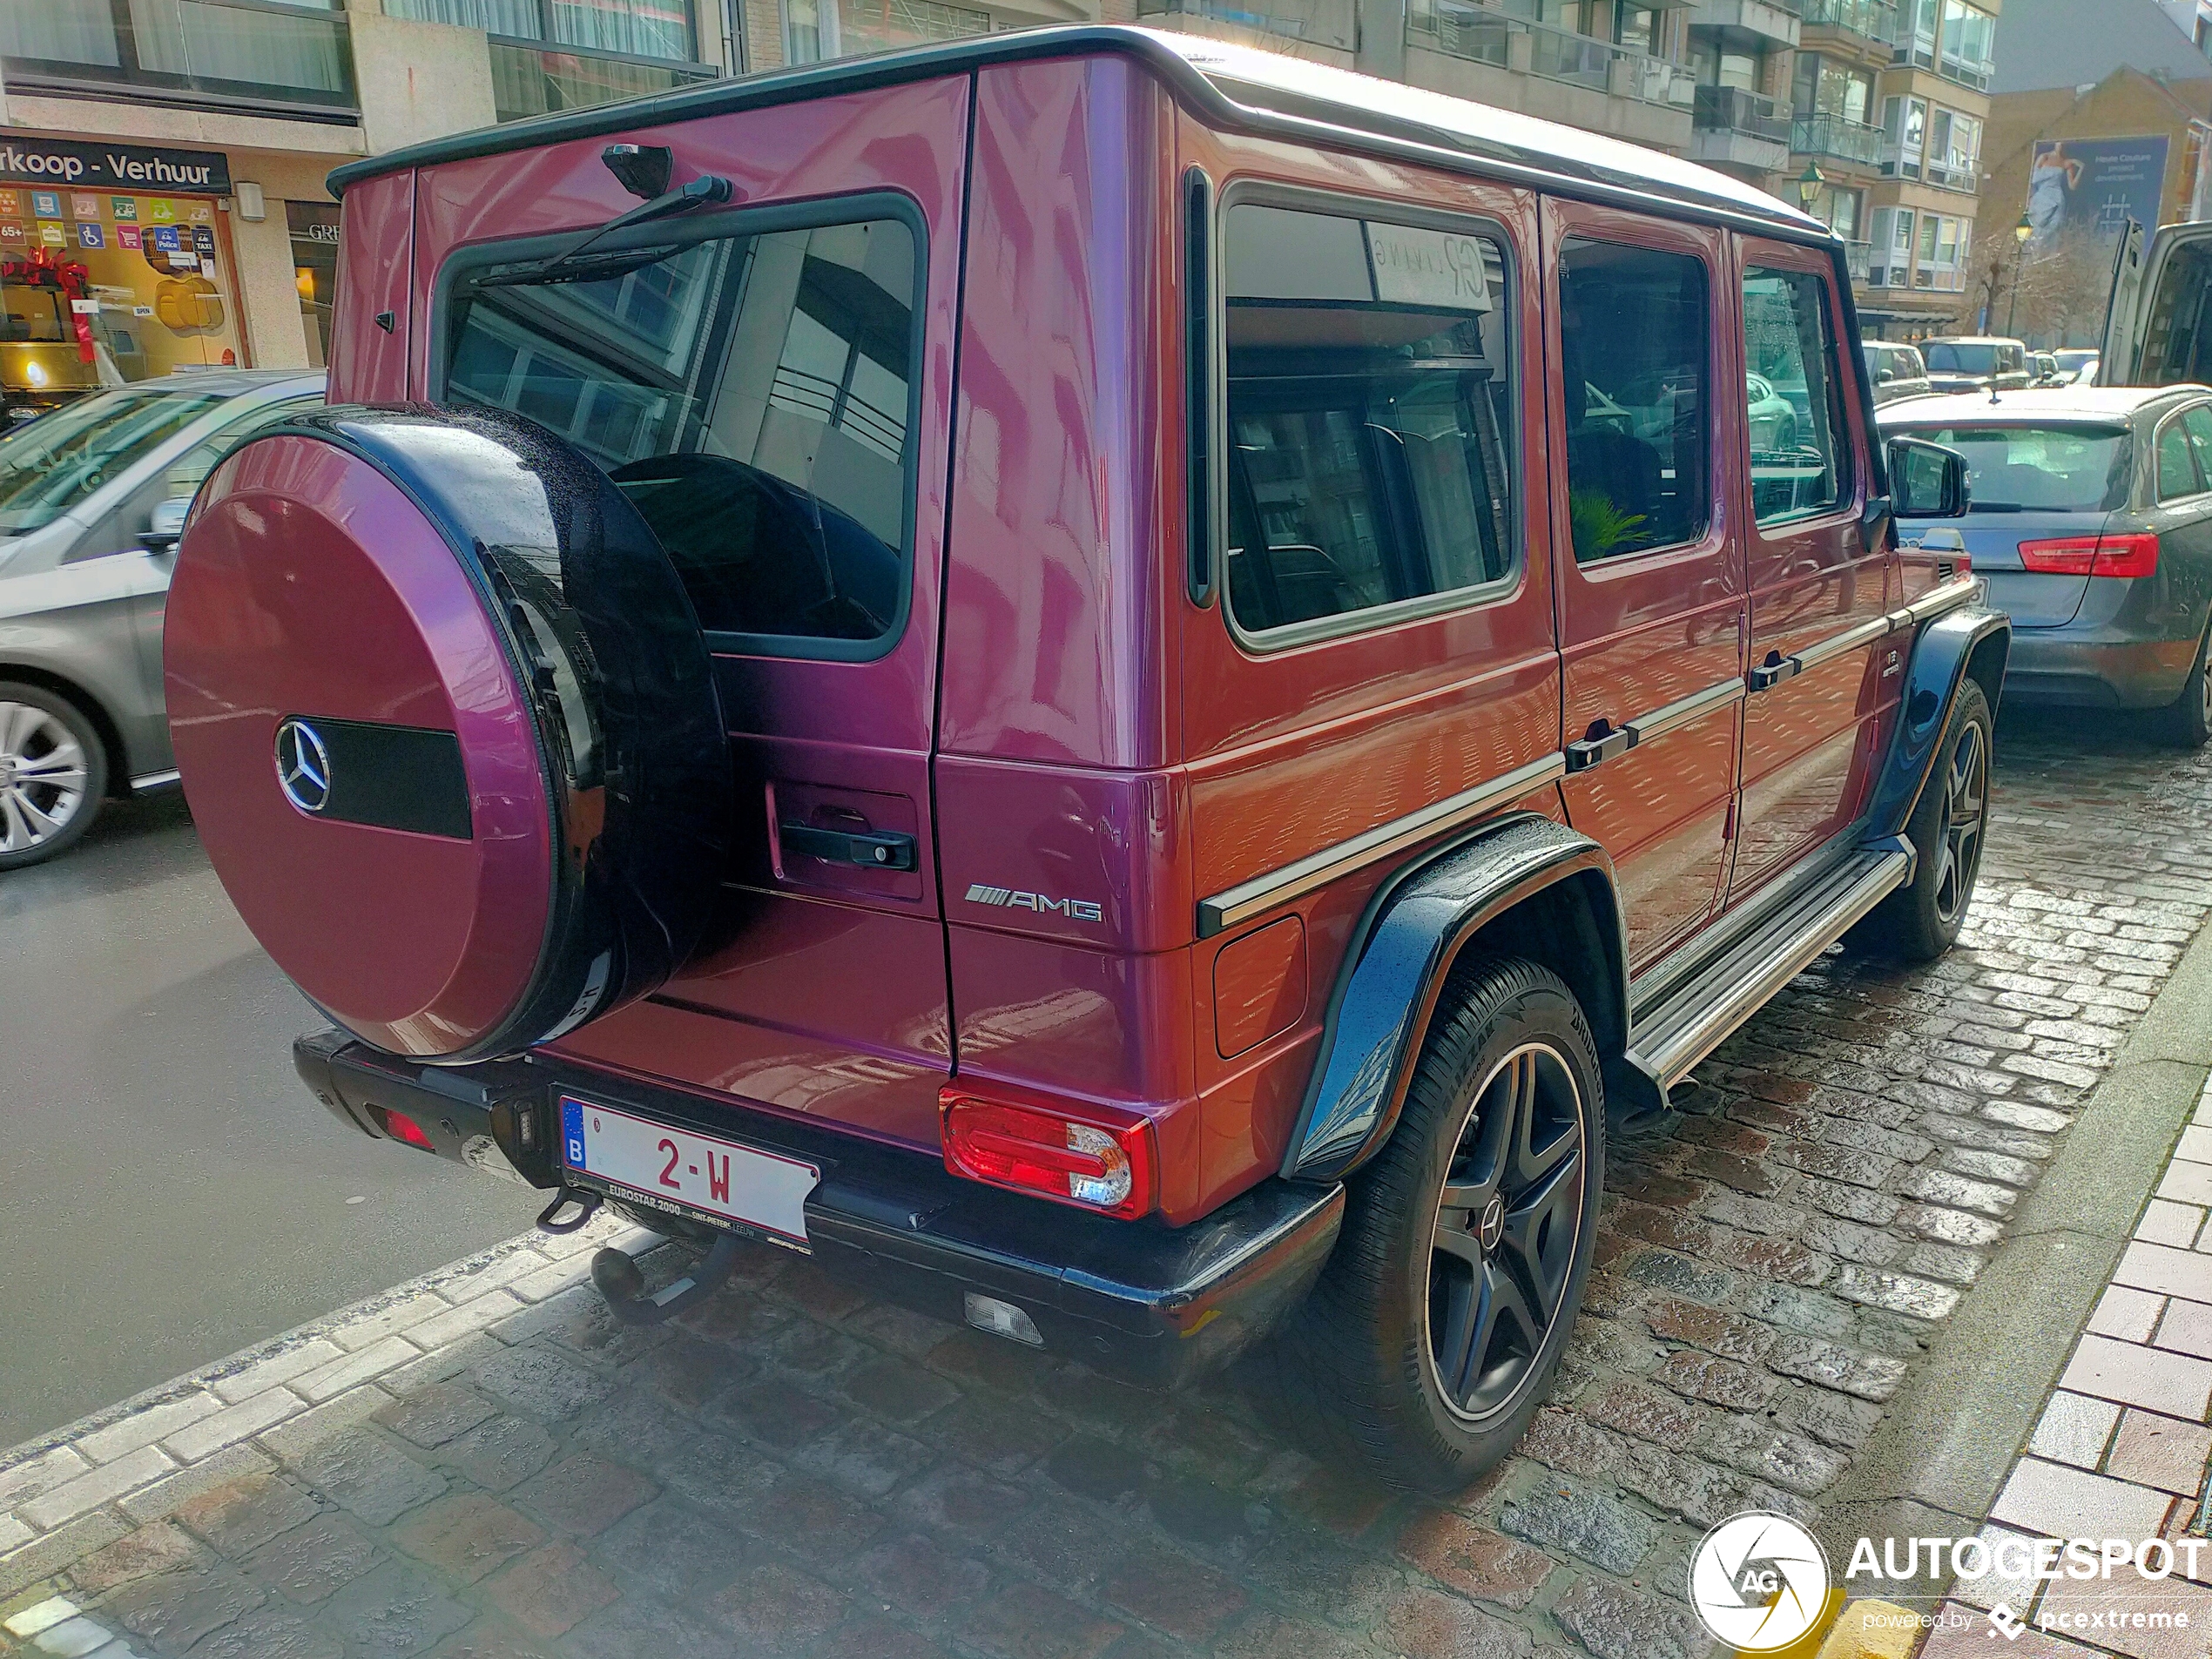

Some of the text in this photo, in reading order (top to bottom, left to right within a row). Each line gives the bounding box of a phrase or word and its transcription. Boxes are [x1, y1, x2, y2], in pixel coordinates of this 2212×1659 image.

[106, 153, 211, 185] Verhuur
[2, 226, 23, 237] 65+
[158, 239, 178, 249] Police
[1006, 890, 1103, 922] AMG
[569, 1138, 583, 1162] B
[610, 1184, 658, 1208] EUROSTAR
[658, 1199, 681, 1216] 2000
